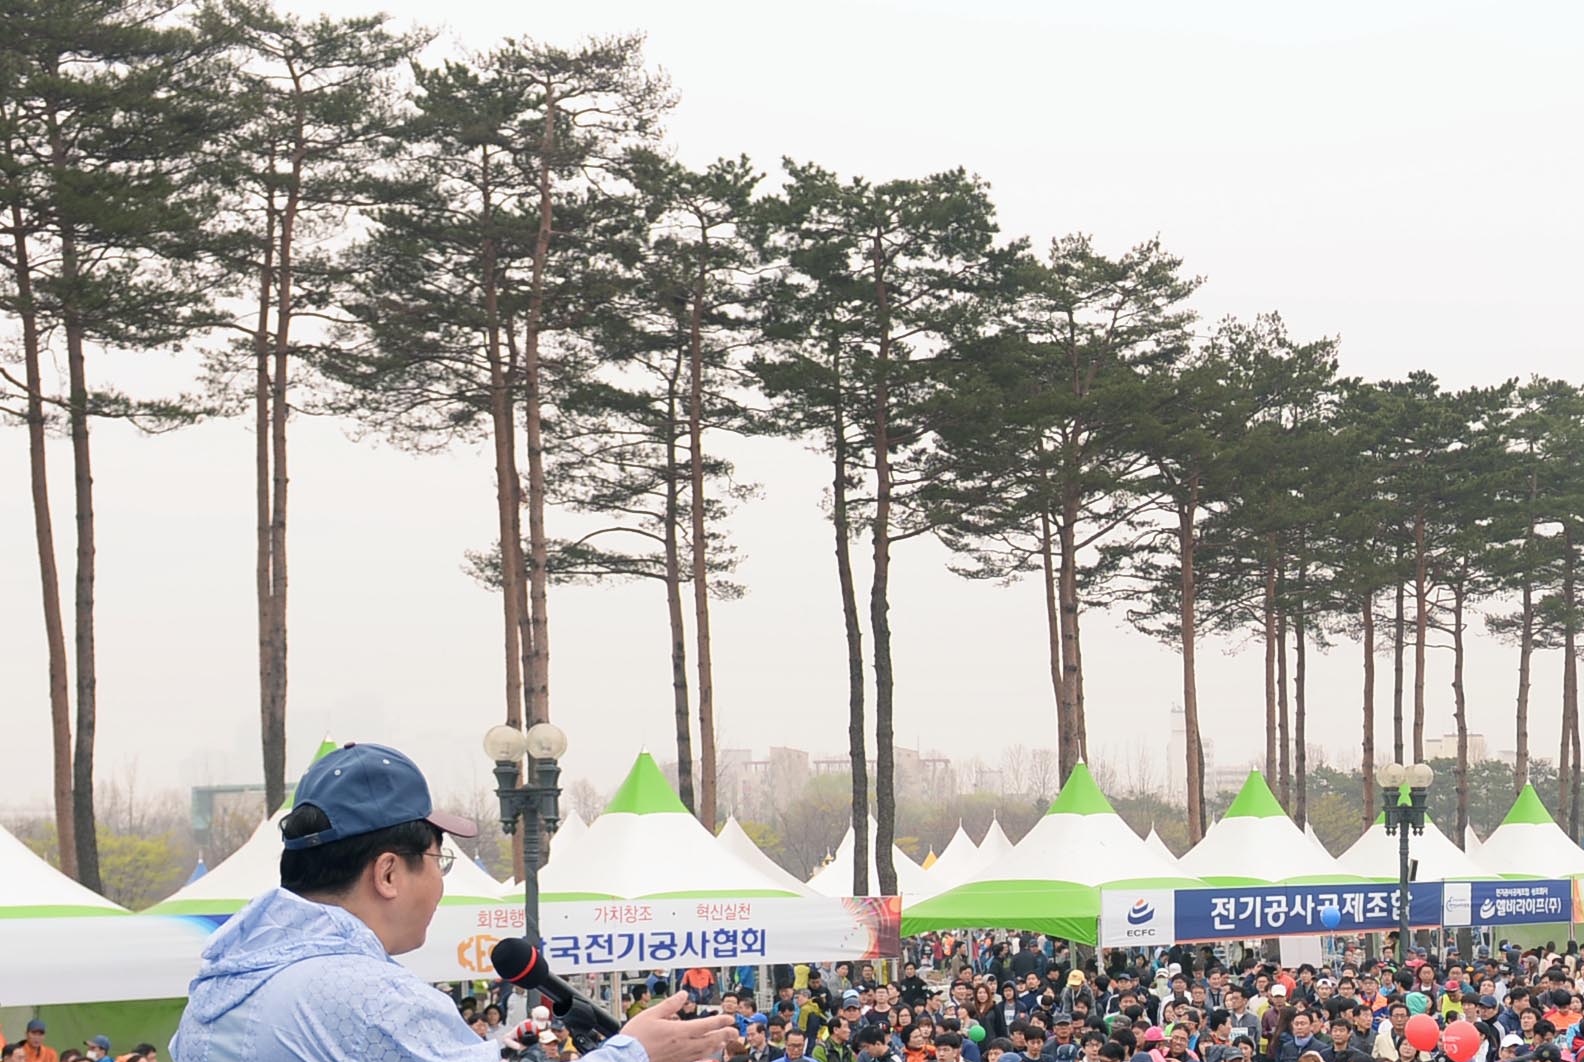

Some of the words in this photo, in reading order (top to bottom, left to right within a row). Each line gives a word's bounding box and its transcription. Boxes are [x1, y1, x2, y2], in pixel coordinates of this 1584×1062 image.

[477, 909, 526, 928] 회원행
[594, 905, 653, 924] 가치창조
[696, 902, 751, 921] 혁신실천
[1126, 928, 1156, 938] ECFC
